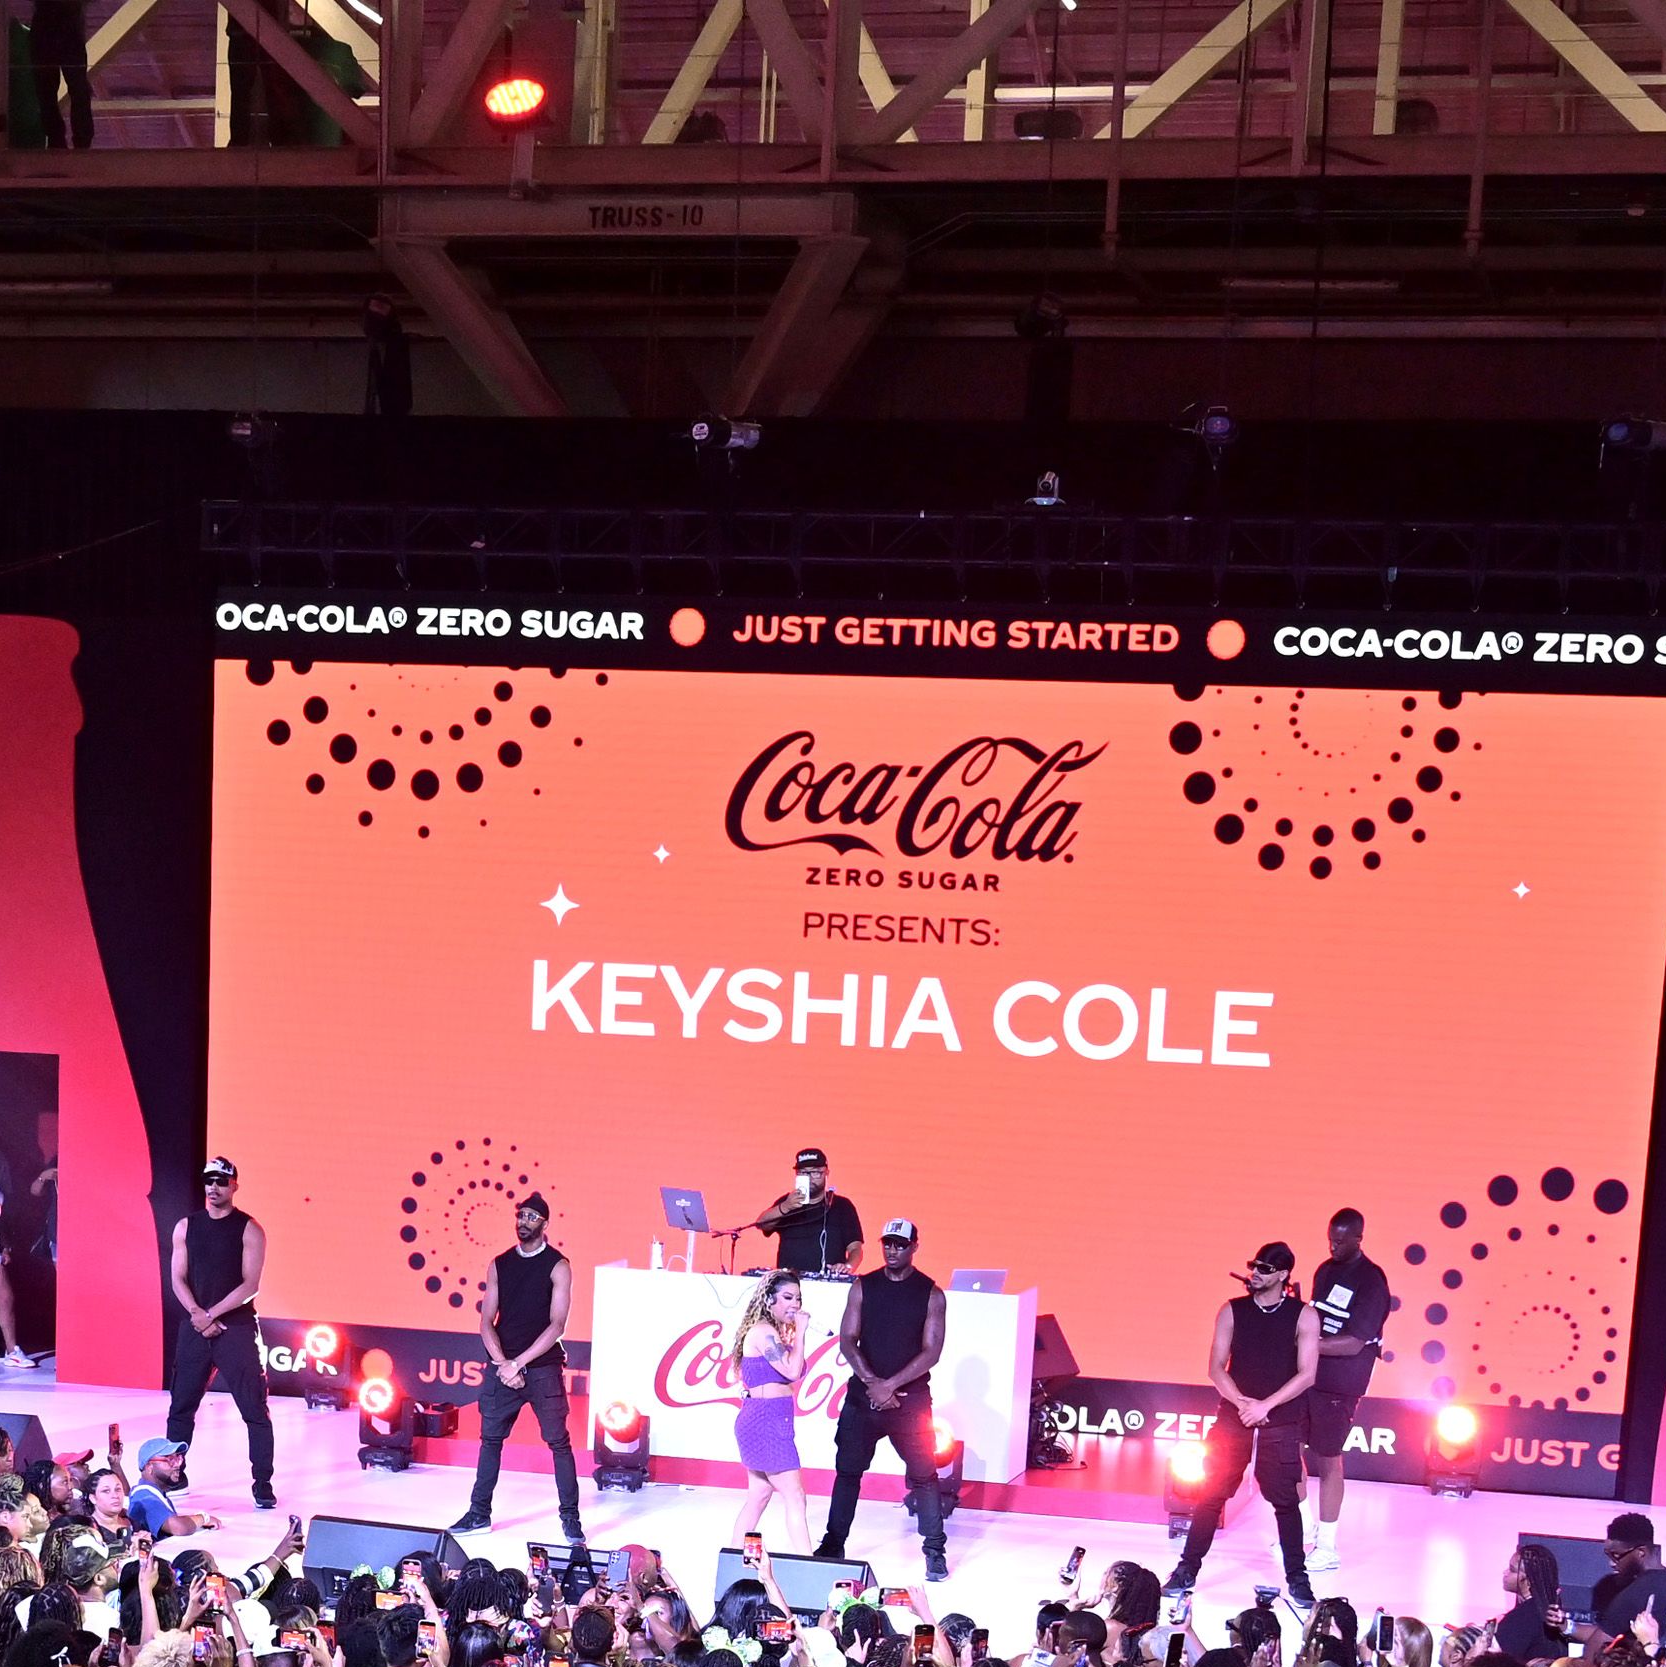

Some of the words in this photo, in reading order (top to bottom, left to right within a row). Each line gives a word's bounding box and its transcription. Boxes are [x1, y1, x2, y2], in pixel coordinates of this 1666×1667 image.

[416, 607, 511, 638] ZERO
[520, 609, 645, 641] SUGAR
[732, 614, 826, 645] JUST
[834, 616, 997, 649] GETTING
[1007, 620, 1180, 653] STARTED
[1533, 632, 1645, 665] ZERO
[805, 866, 885, 889] ZERO
[897, 870, 1002, 893] SUGAR
[803, 912, 1002, 948] PRESENTS:
[530, 958, 963, 1054] KEYSHIA
[992, 980, 1275, 1069] COLE
[418, 1358, 487, 1387] JUS
[1490, 1436, 1590, 1468] JUST
